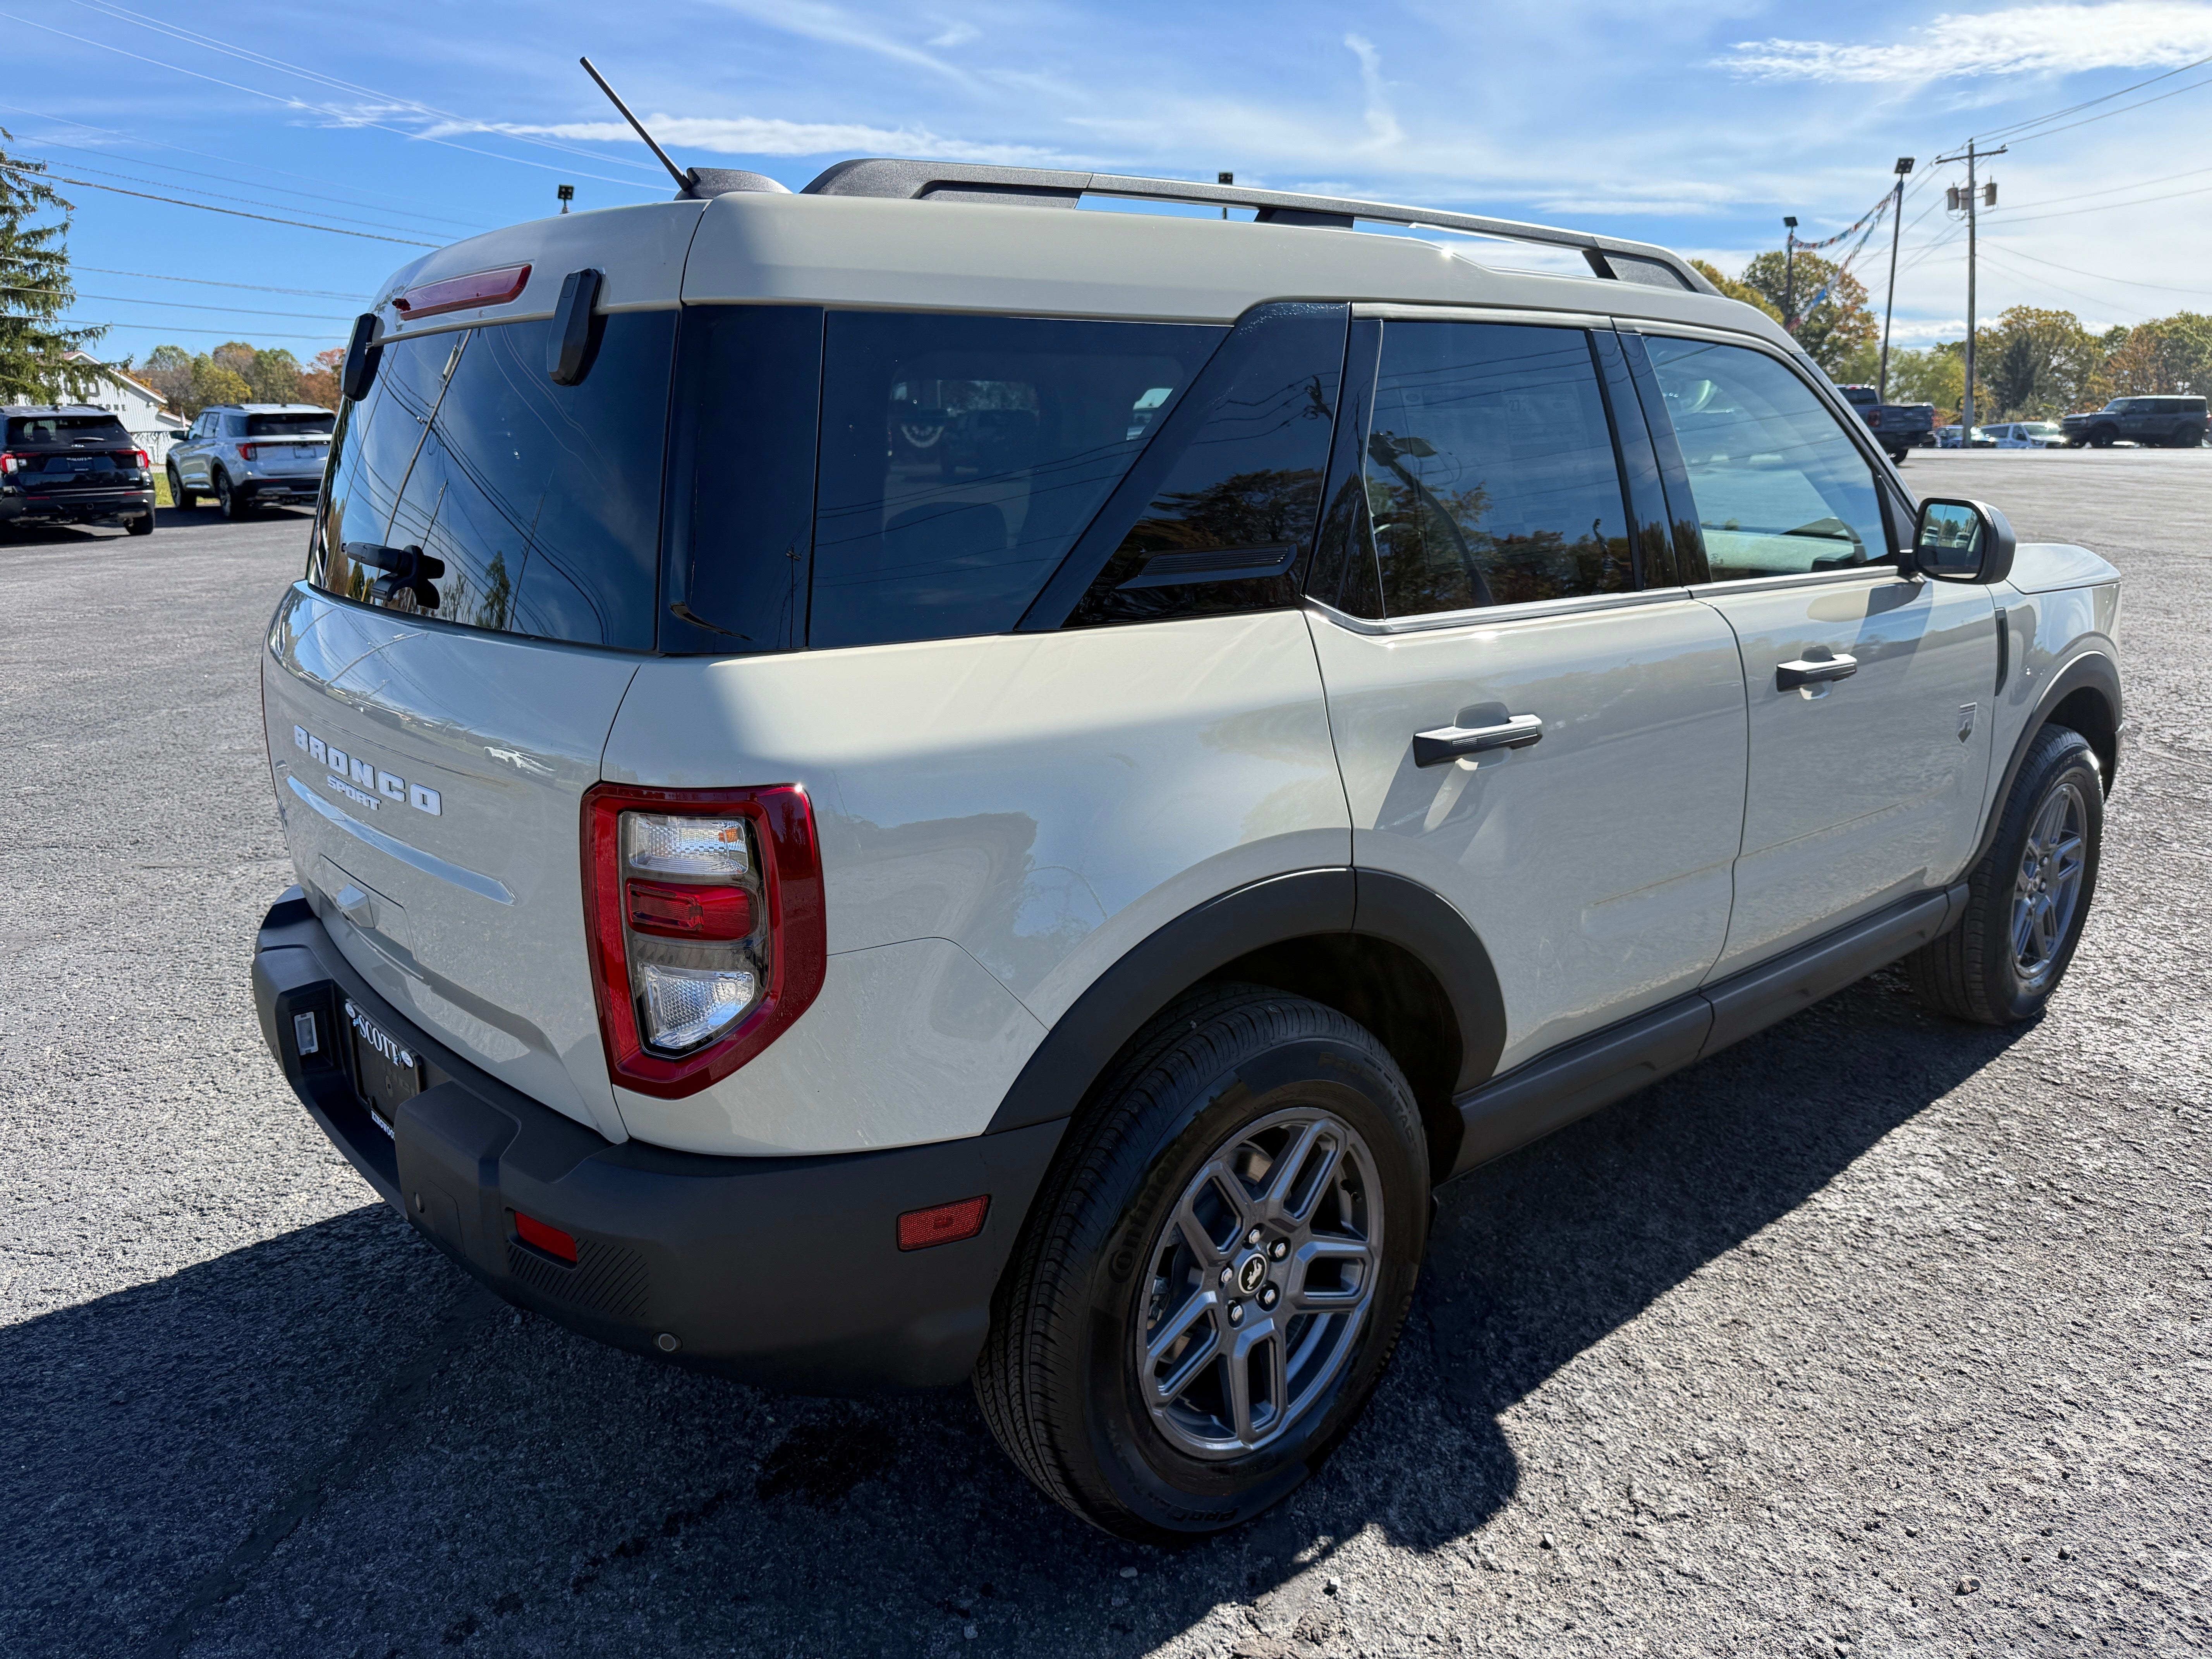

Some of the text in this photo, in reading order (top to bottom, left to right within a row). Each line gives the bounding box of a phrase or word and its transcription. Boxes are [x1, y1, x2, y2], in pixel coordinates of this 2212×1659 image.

[294, 725, 442, 816] BRONCO
[327, 775, 382, 811] SPORT
[358, 1015, 399, 1066] SCOTT
[371, 1110, 395, 1141] KINGWOO
